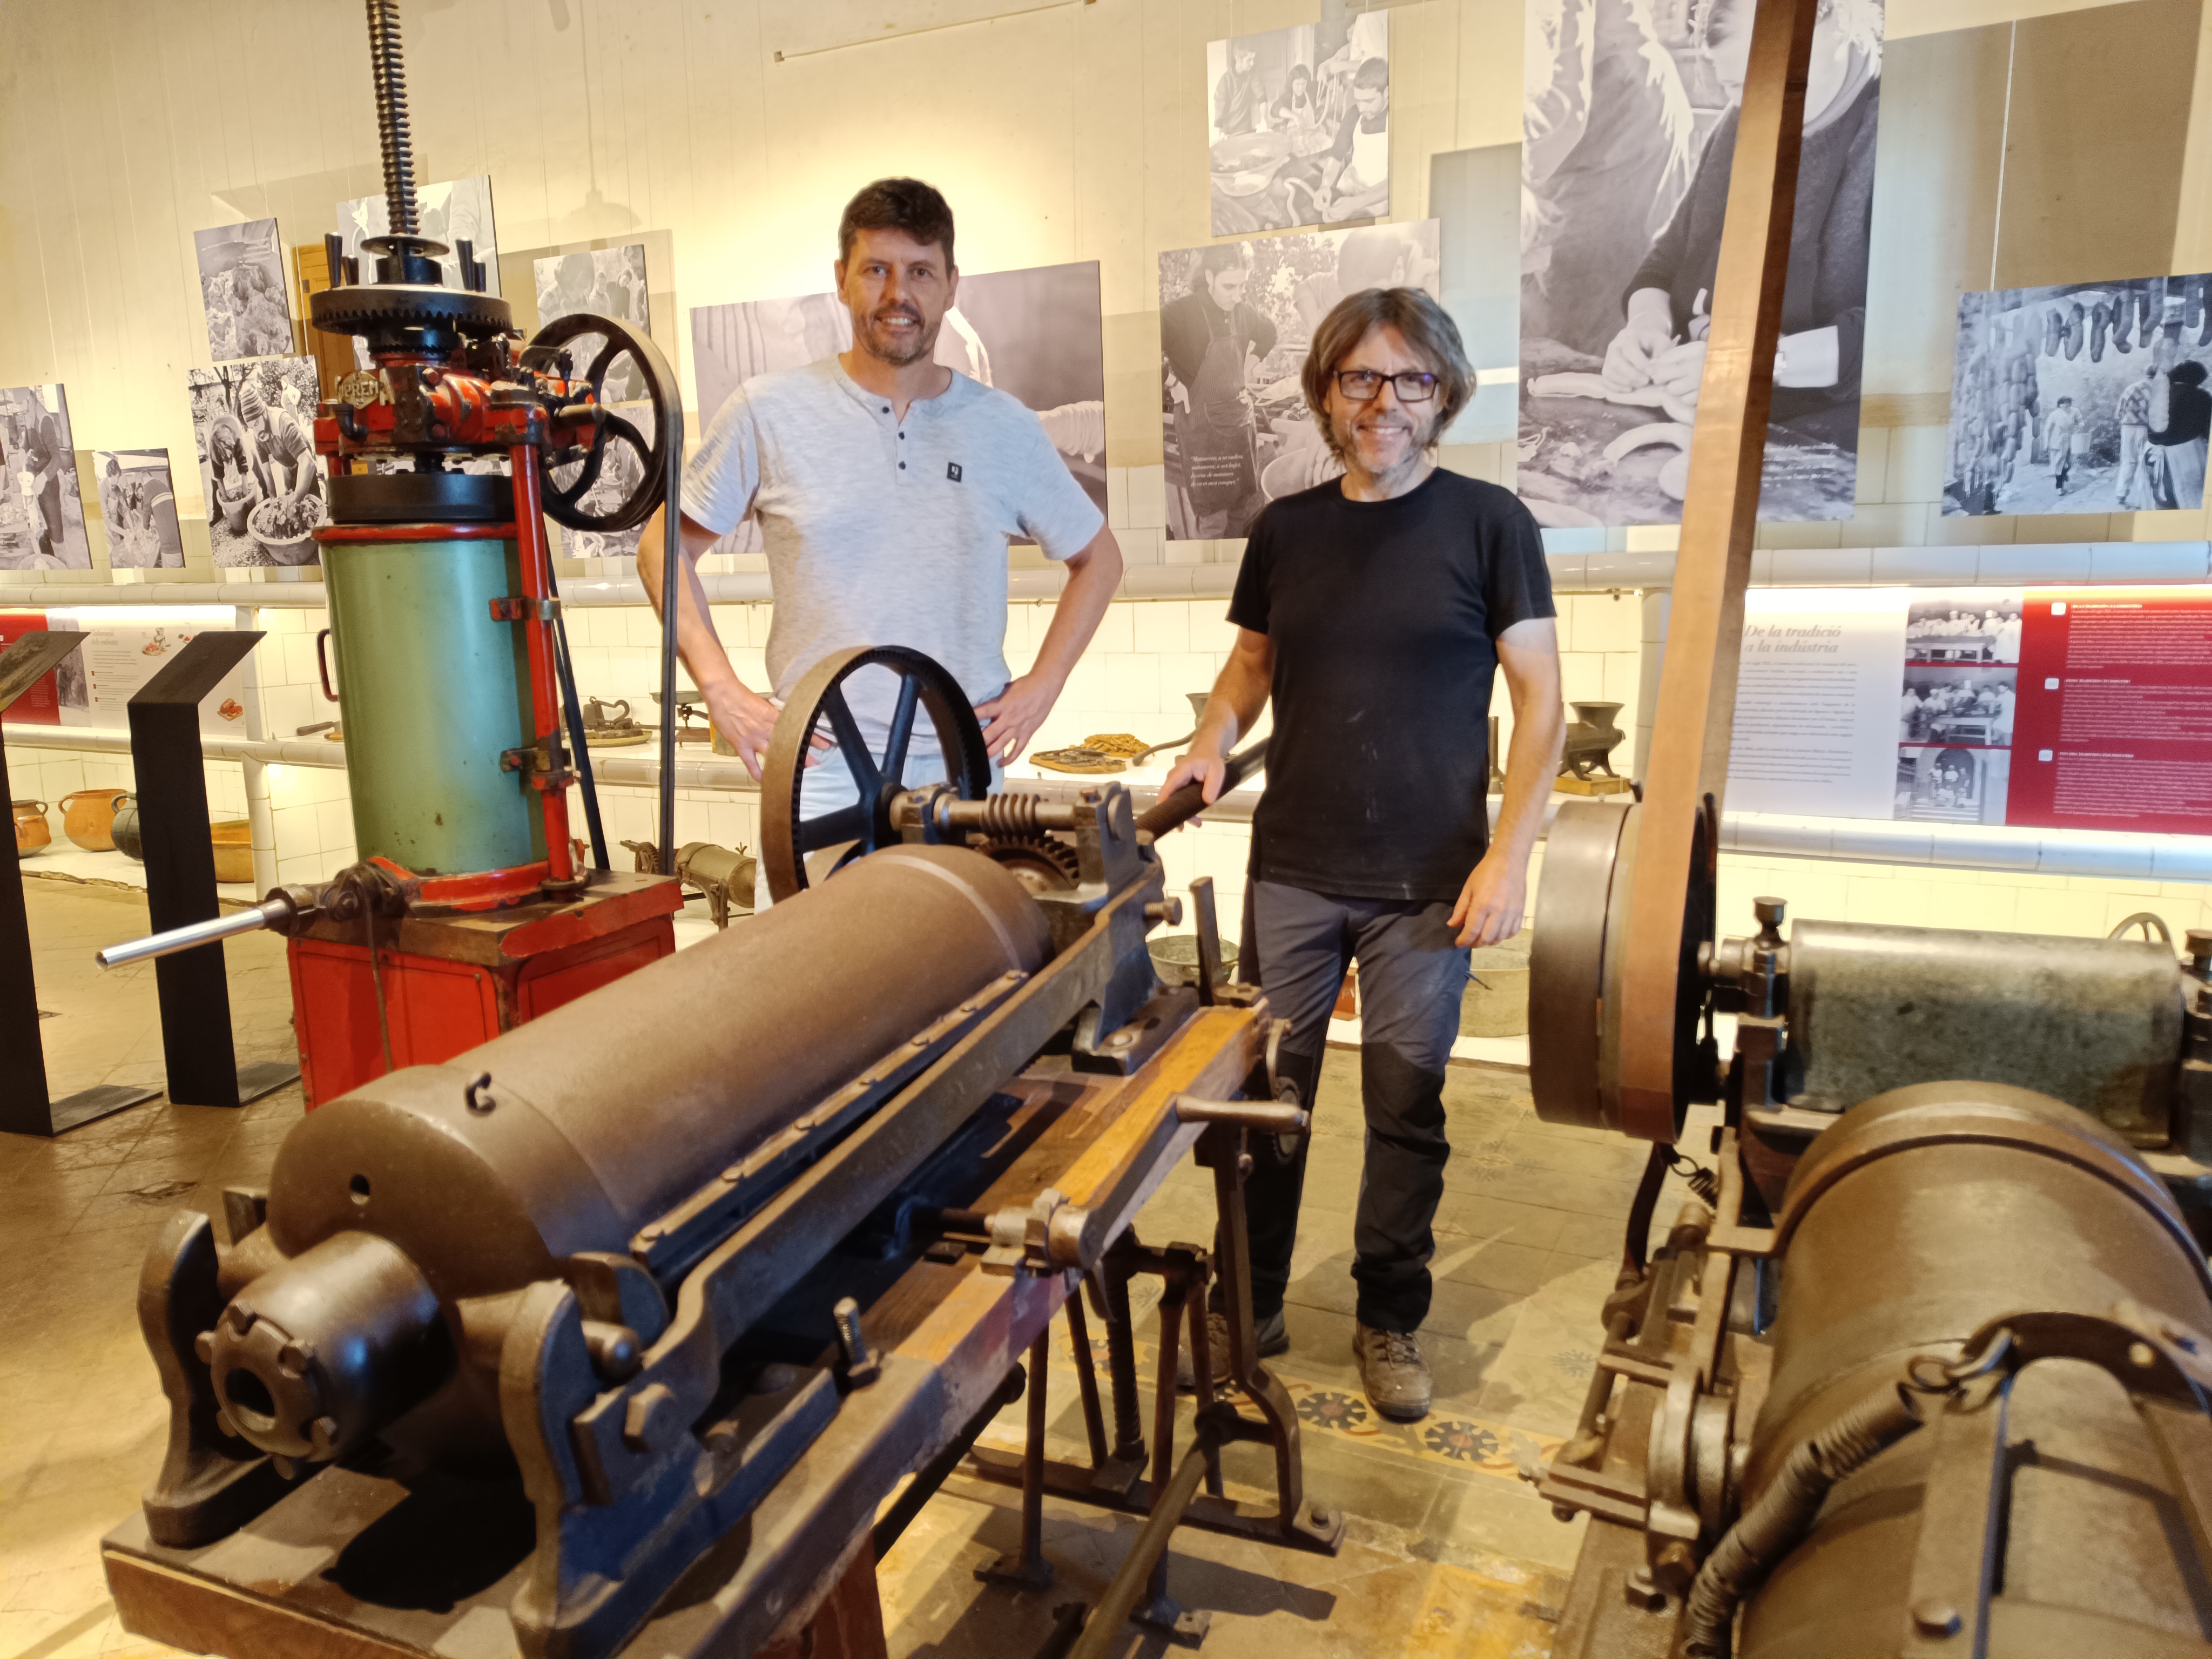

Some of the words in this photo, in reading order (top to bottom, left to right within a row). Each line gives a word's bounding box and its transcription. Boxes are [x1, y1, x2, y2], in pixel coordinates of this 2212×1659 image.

[1744, 625, 1765, 637] De
[1768, 624, 1782, 637] la
[1784, 624, 1842, 637] tradició
[1744, 643, 1754, 652] a
[1757, 639, 1771, 652] la
[1773, 639, 1839, 653] indústria
